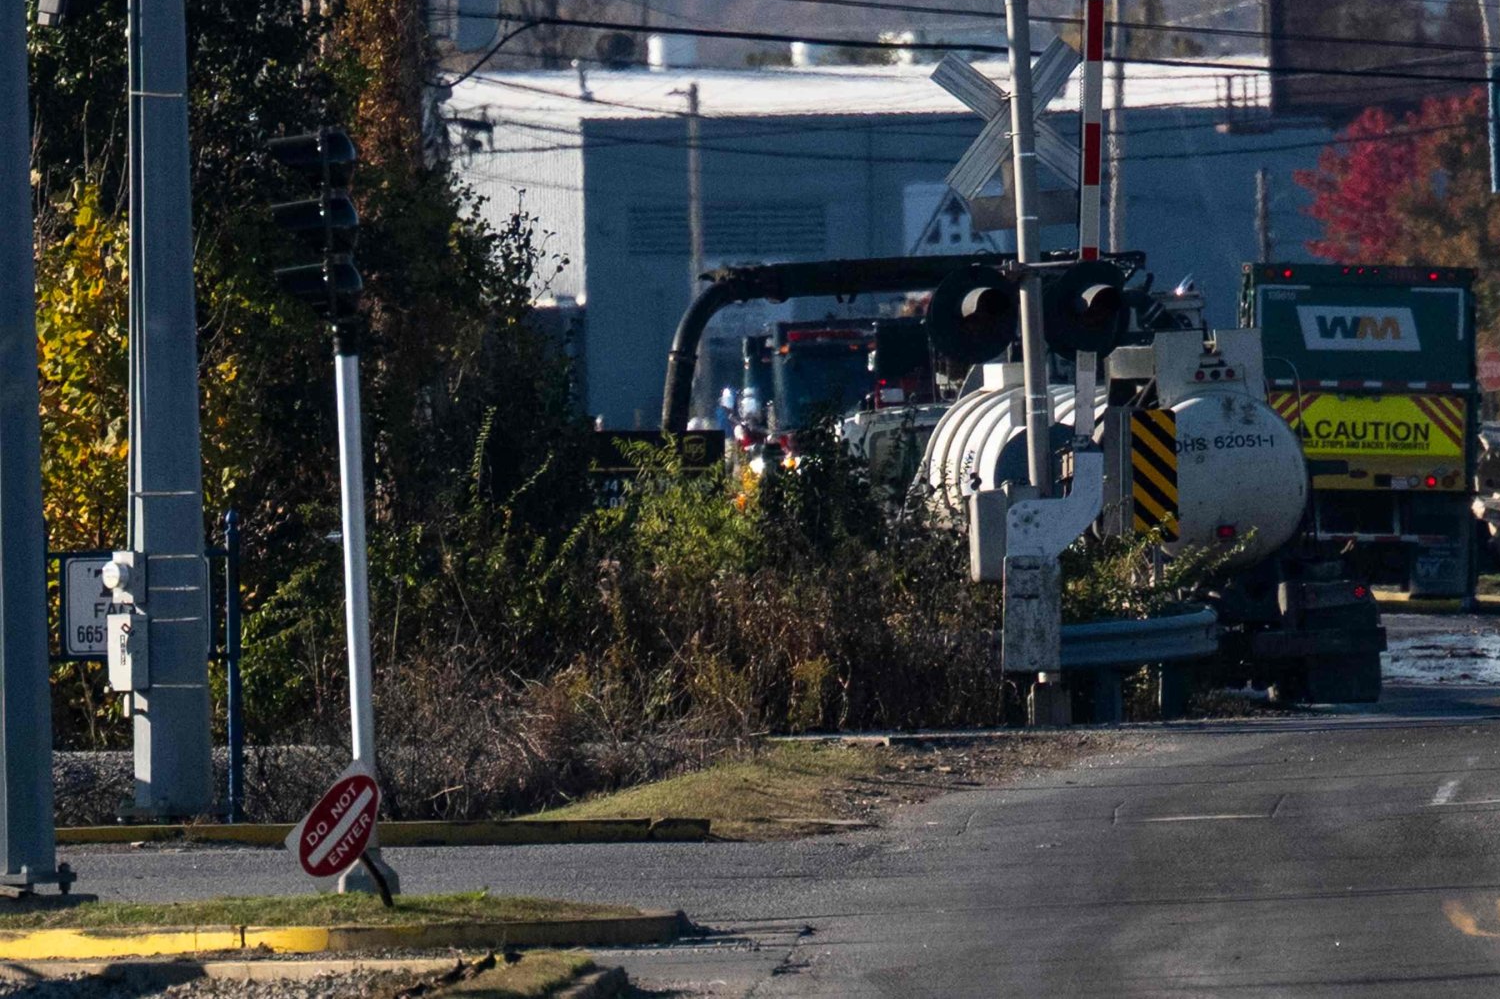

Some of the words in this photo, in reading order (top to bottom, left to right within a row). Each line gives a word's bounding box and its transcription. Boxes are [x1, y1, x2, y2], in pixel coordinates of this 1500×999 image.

[1315, 314, 1402, 340] WM
[1314, 419, 1430, 442] CAUTION
[305, 821, 329, 847] DO
[330, 782, 358, 820] NOT
[327, 812, 372, 867] ENTER
